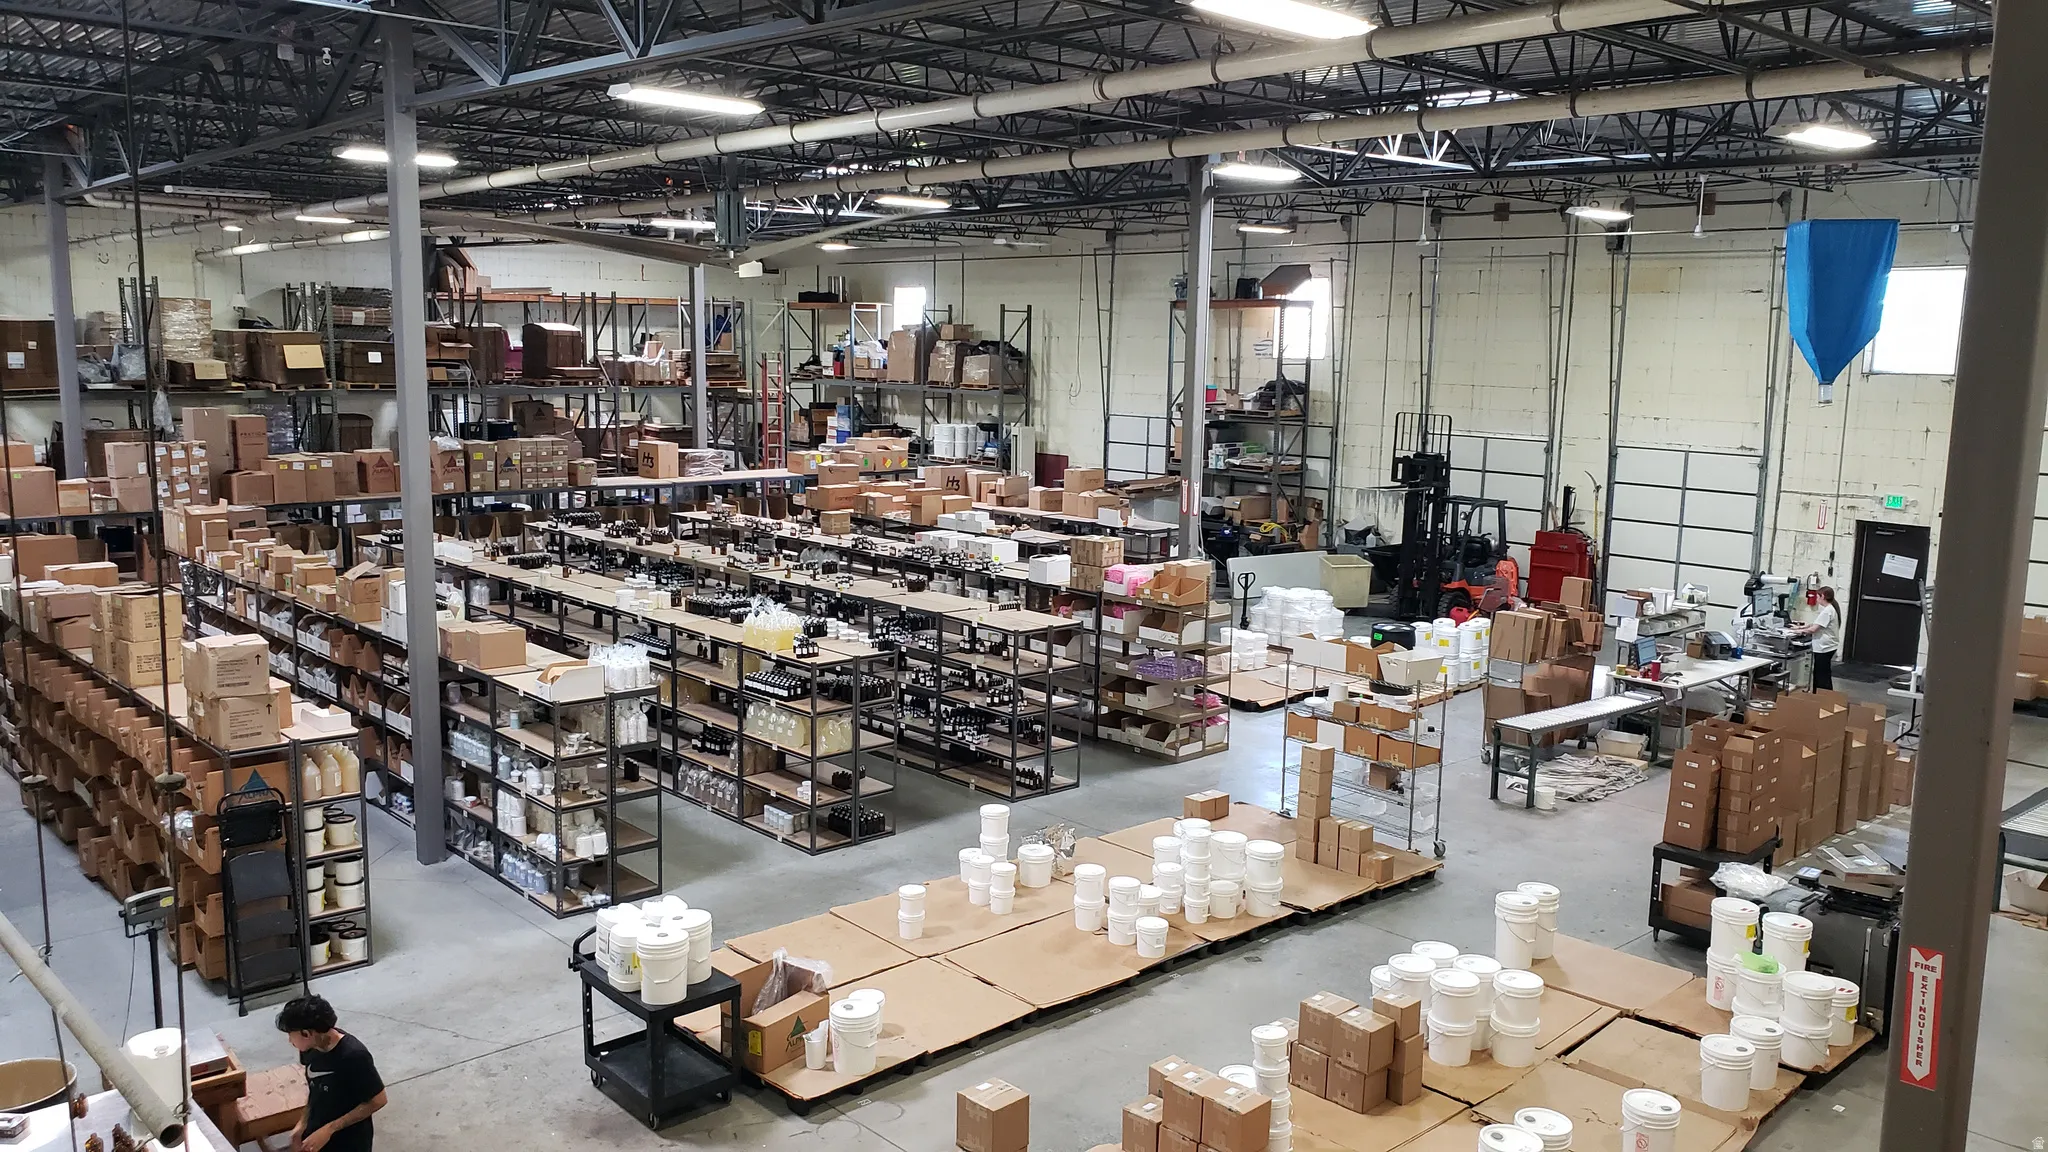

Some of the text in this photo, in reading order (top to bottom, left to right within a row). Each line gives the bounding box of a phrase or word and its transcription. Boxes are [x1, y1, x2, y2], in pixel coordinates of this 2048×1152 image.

[1886, 495, 1903, 508] EXIT
[1914, 961, 1938, 974] FIRE
[1915, 975, 1928, 1068] EXTINGUISHER
